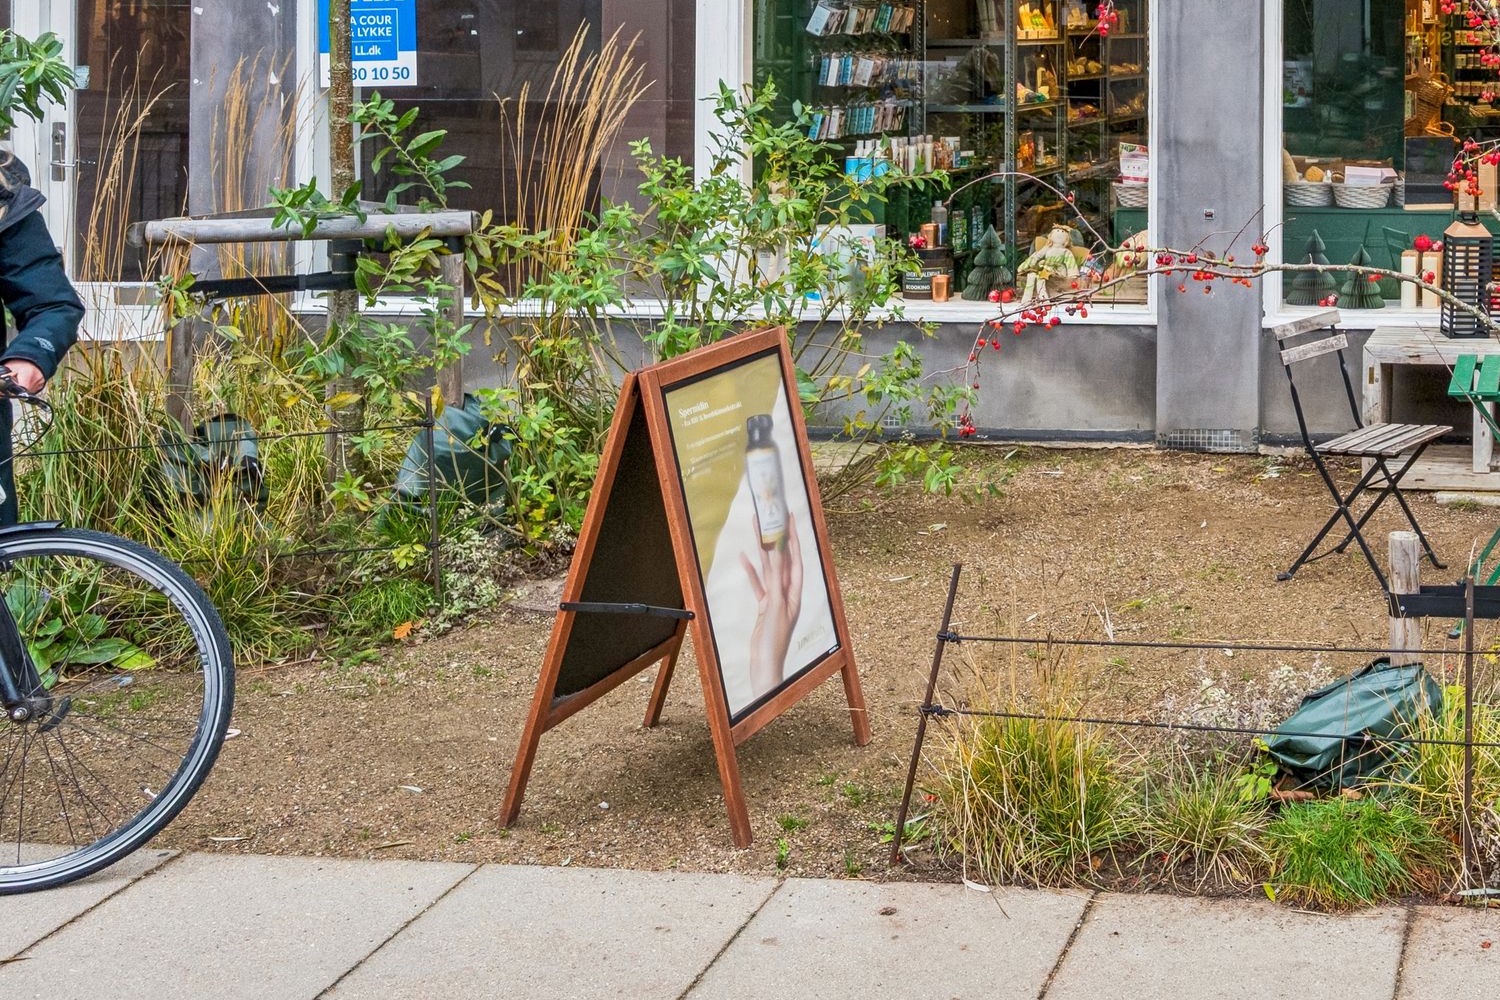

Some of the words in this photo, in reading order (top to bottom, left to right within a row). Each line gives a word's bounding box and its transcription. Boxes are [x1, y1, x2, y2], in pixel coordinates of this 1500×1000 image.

[359, 15, 392, 26] COUR
[357, 27, 392, 38] LYKKE
[354, 45, 381, 56] LL.dk
[371, 67, 389, 81] 10
[392, 66, 410, 80] 50
